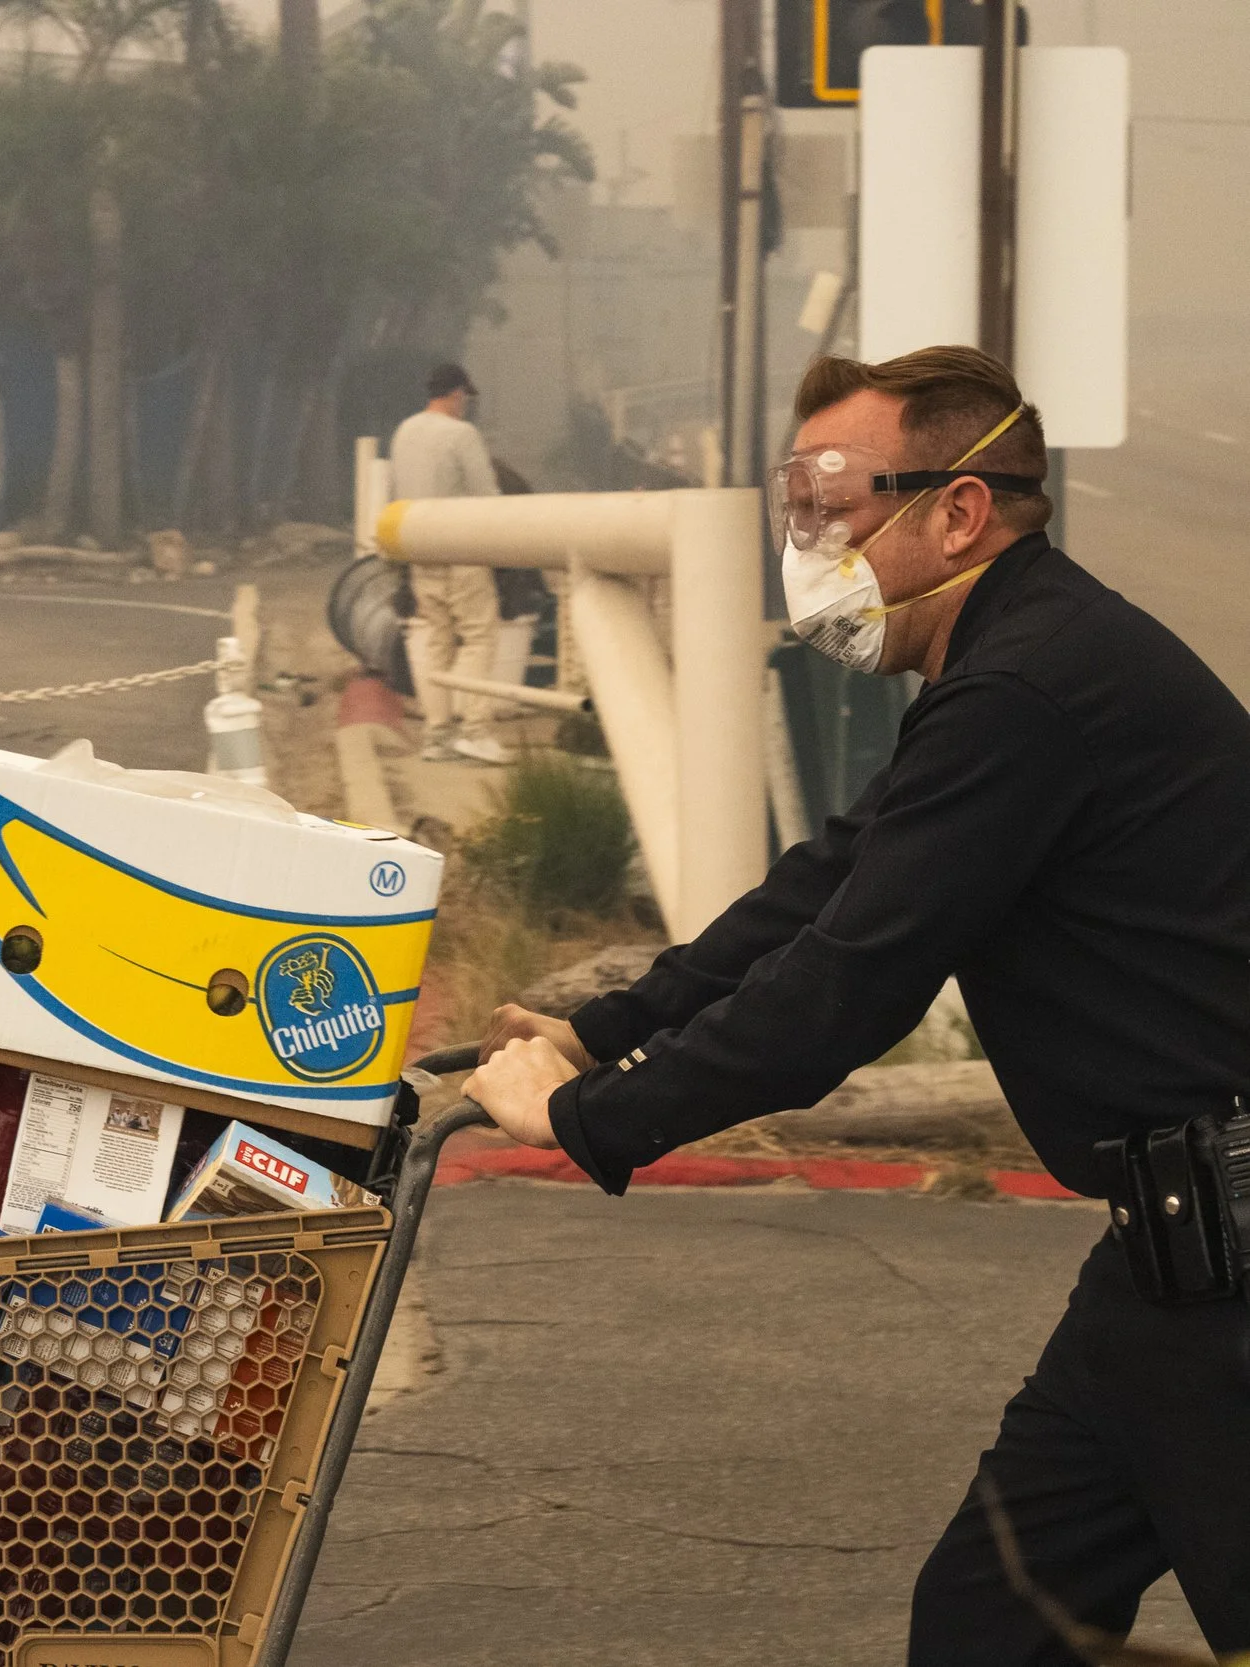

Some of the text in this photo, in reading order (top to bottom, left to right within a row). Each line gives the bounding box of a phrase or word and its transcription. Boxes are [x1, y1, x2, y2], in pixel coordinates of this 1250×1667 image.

[375, 866, 399, 891] M
[272, 1003, 382, 1059] Chiquita
[35, 1078, 83, 1093] Nutrition Facts
[68, 1103, 82, 1112] 250
[241, 1146, 253, 1163] BAR
[251, 1152, 304, 1188] CLIF
